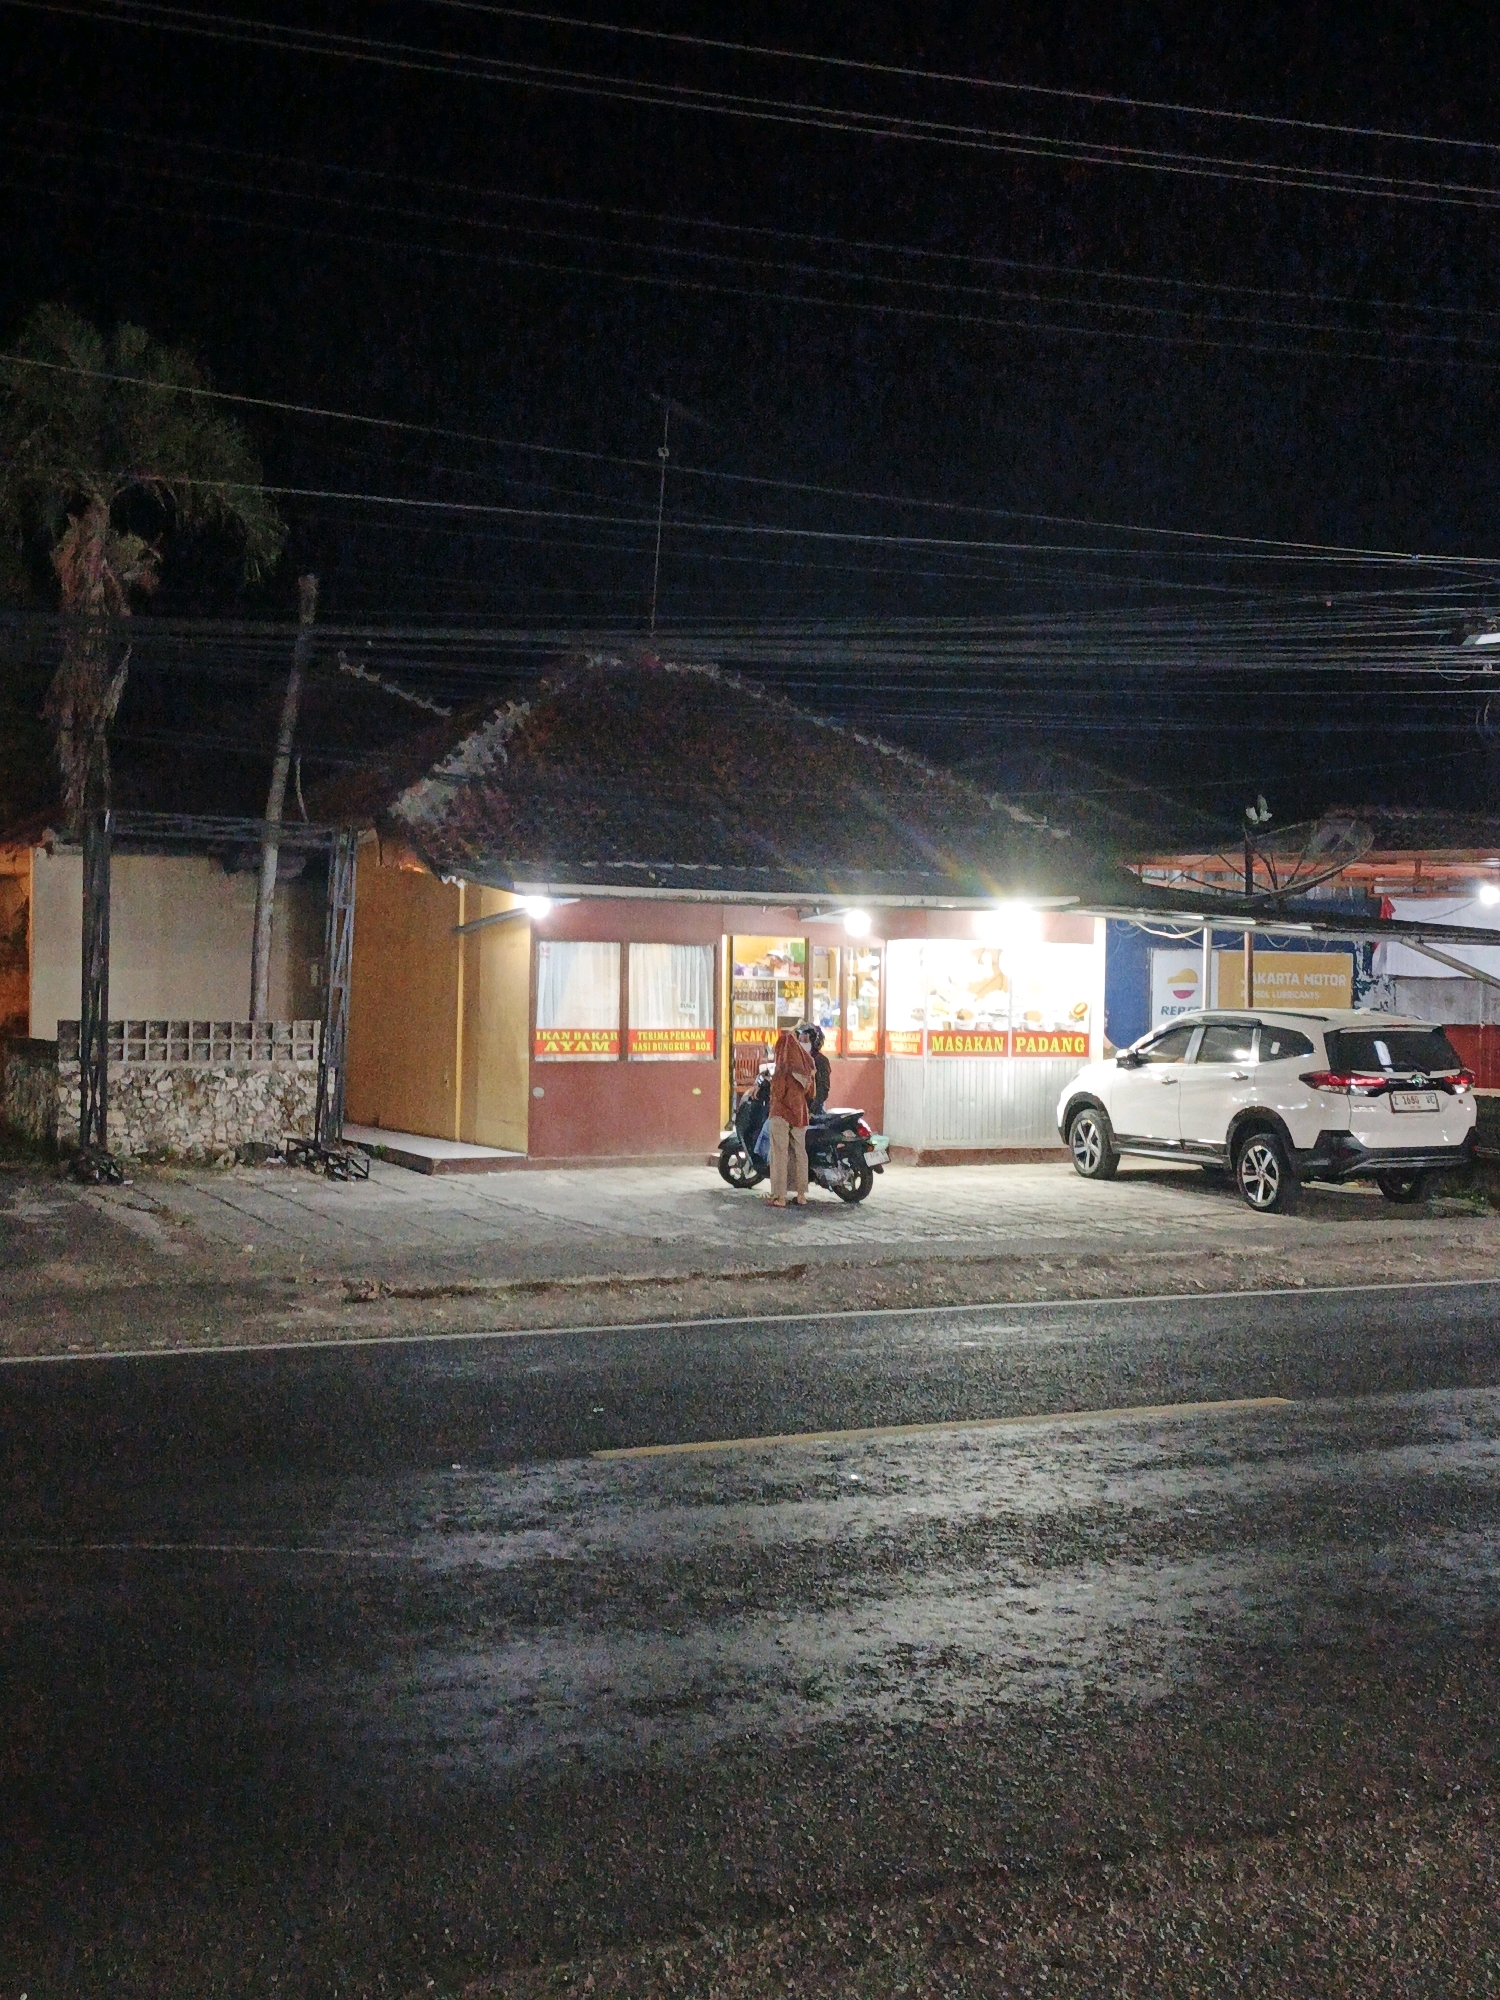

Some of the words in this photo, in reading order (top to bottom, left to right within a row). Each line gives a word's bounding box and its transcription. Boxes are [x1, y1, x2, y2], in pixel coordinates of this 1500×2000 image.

[1303, 973, 1347, 987] MOTOR
[536, 1031, 570, 1041] IKAN
[573, 1031, 618, 1041] BAKAR
[637, 1031, 669, 1041] TERIMA
[670, 1031, 706, 1041] PESANAN
[733, 1029, 779, 1046] ASAKAN
[544, 1041, 611, 1052] AYAM
[632, 1041, 651, 1052] NASI
[652, 1041, 690, 1052] BUNGKUS
[695, 1041, 711, 1051] BOX
[931, 1036, 1004, 1053] MASAKAN
[1015, 1036, 1085, 1054] PADANG
